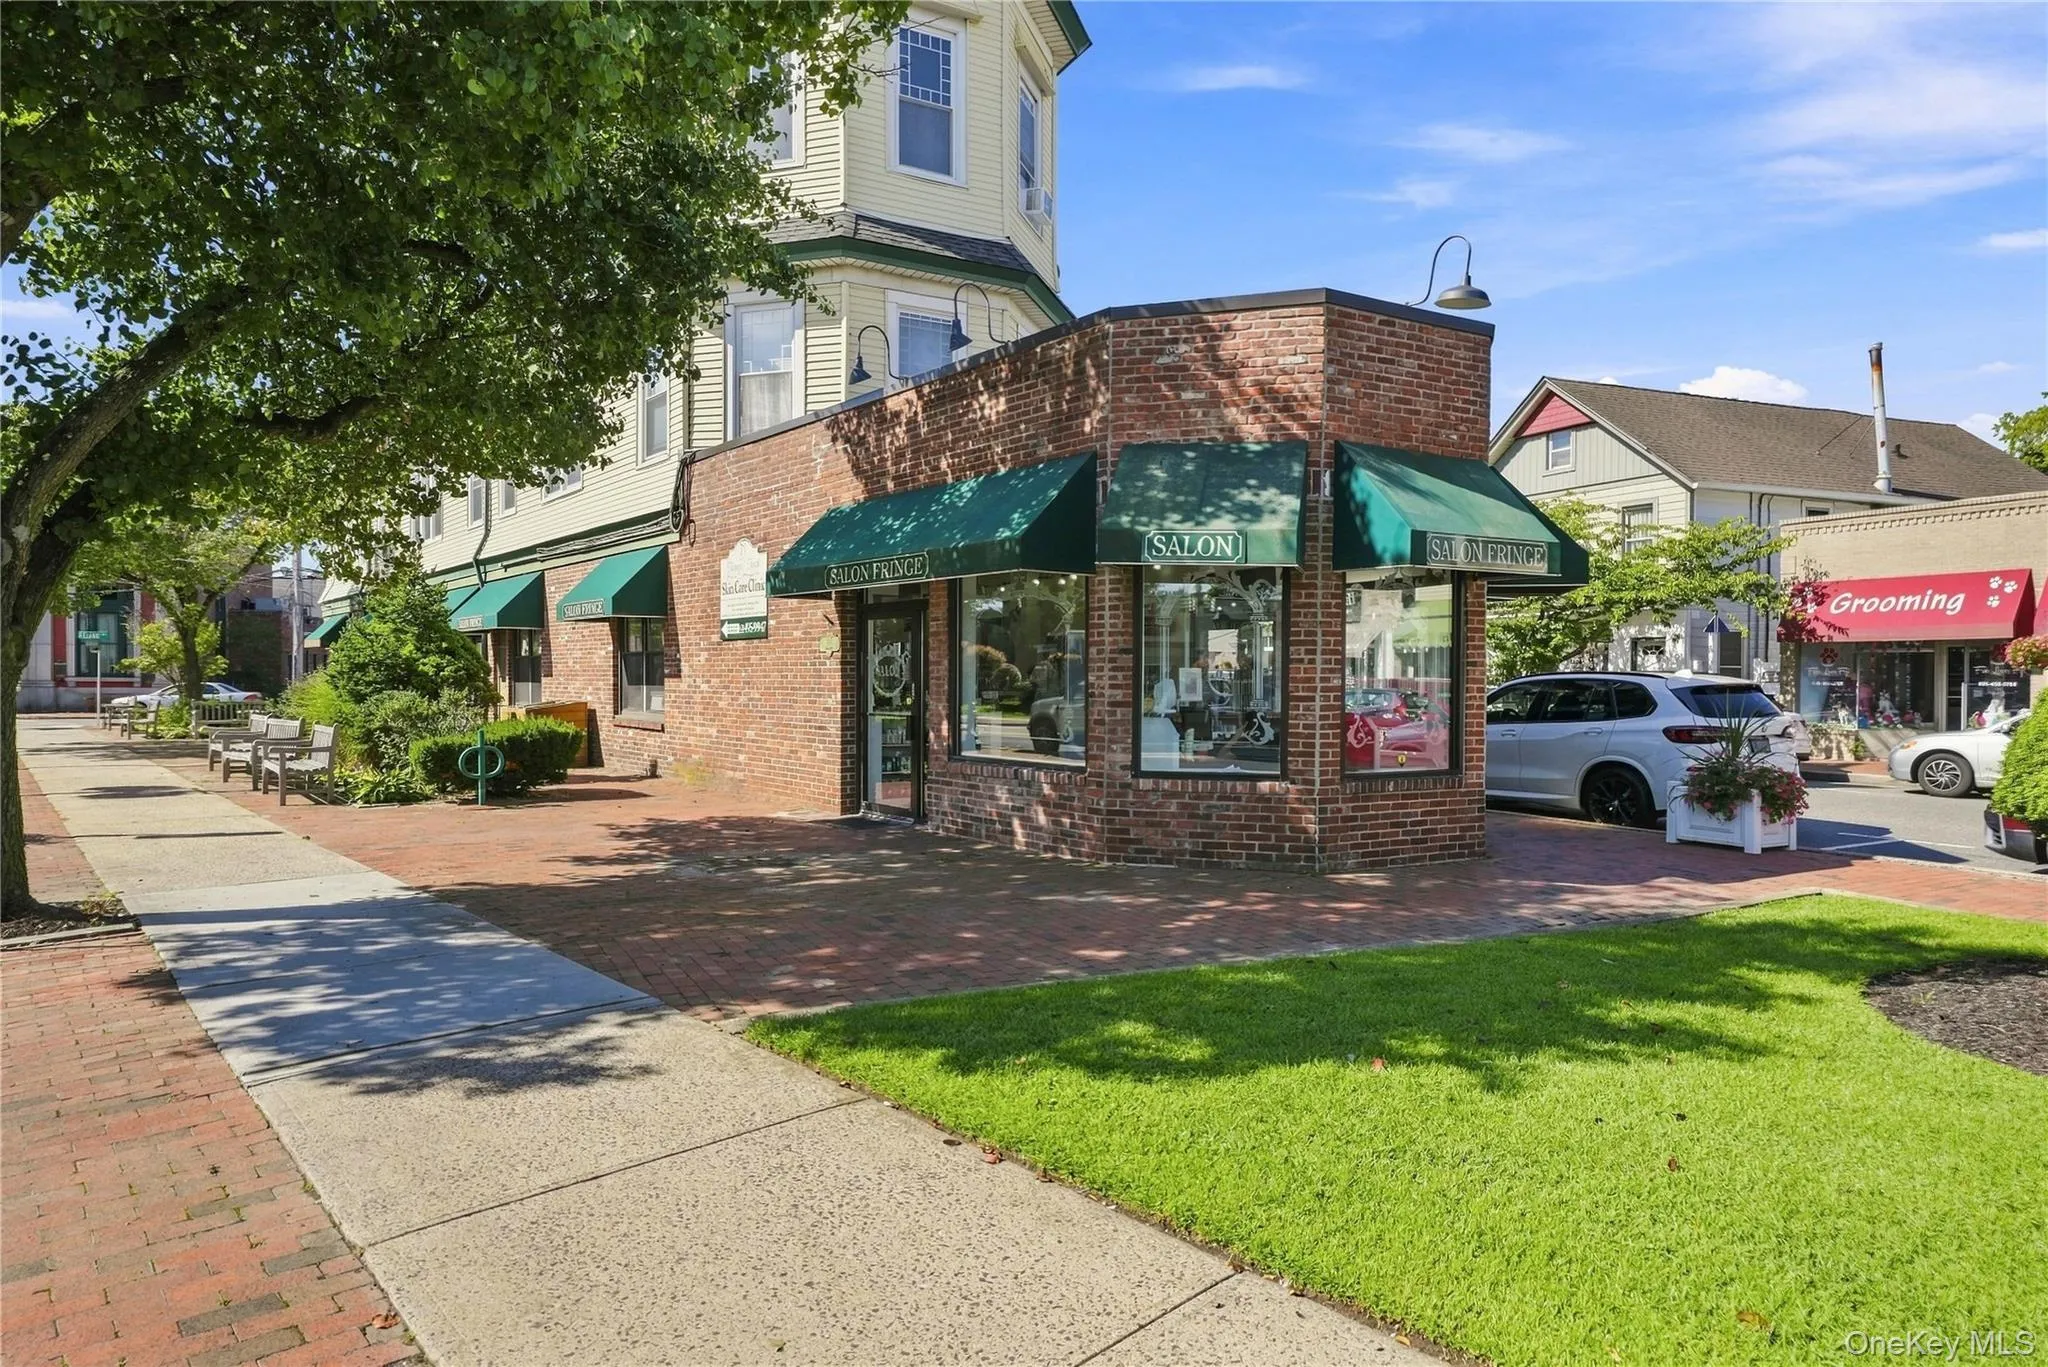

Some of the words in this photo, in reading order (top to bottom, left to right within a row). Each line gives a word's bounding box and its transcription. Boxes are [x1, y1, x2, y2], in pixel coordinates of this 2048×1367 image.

[1152, 535, 1234, 557] SALON
[1431, 538, 1483, 563] SALON
[1487, 543, 1545, 567] FRINGE
[829, 564, 870, 586] SALON
[872, 556, 925, 581] FRINGE
[722, 582, 734, 596] Skin
[734, 579, 747, 594] Care
[564, 604, 581, 618] SALON
[1829, 589, 1966, 616] Grooming
